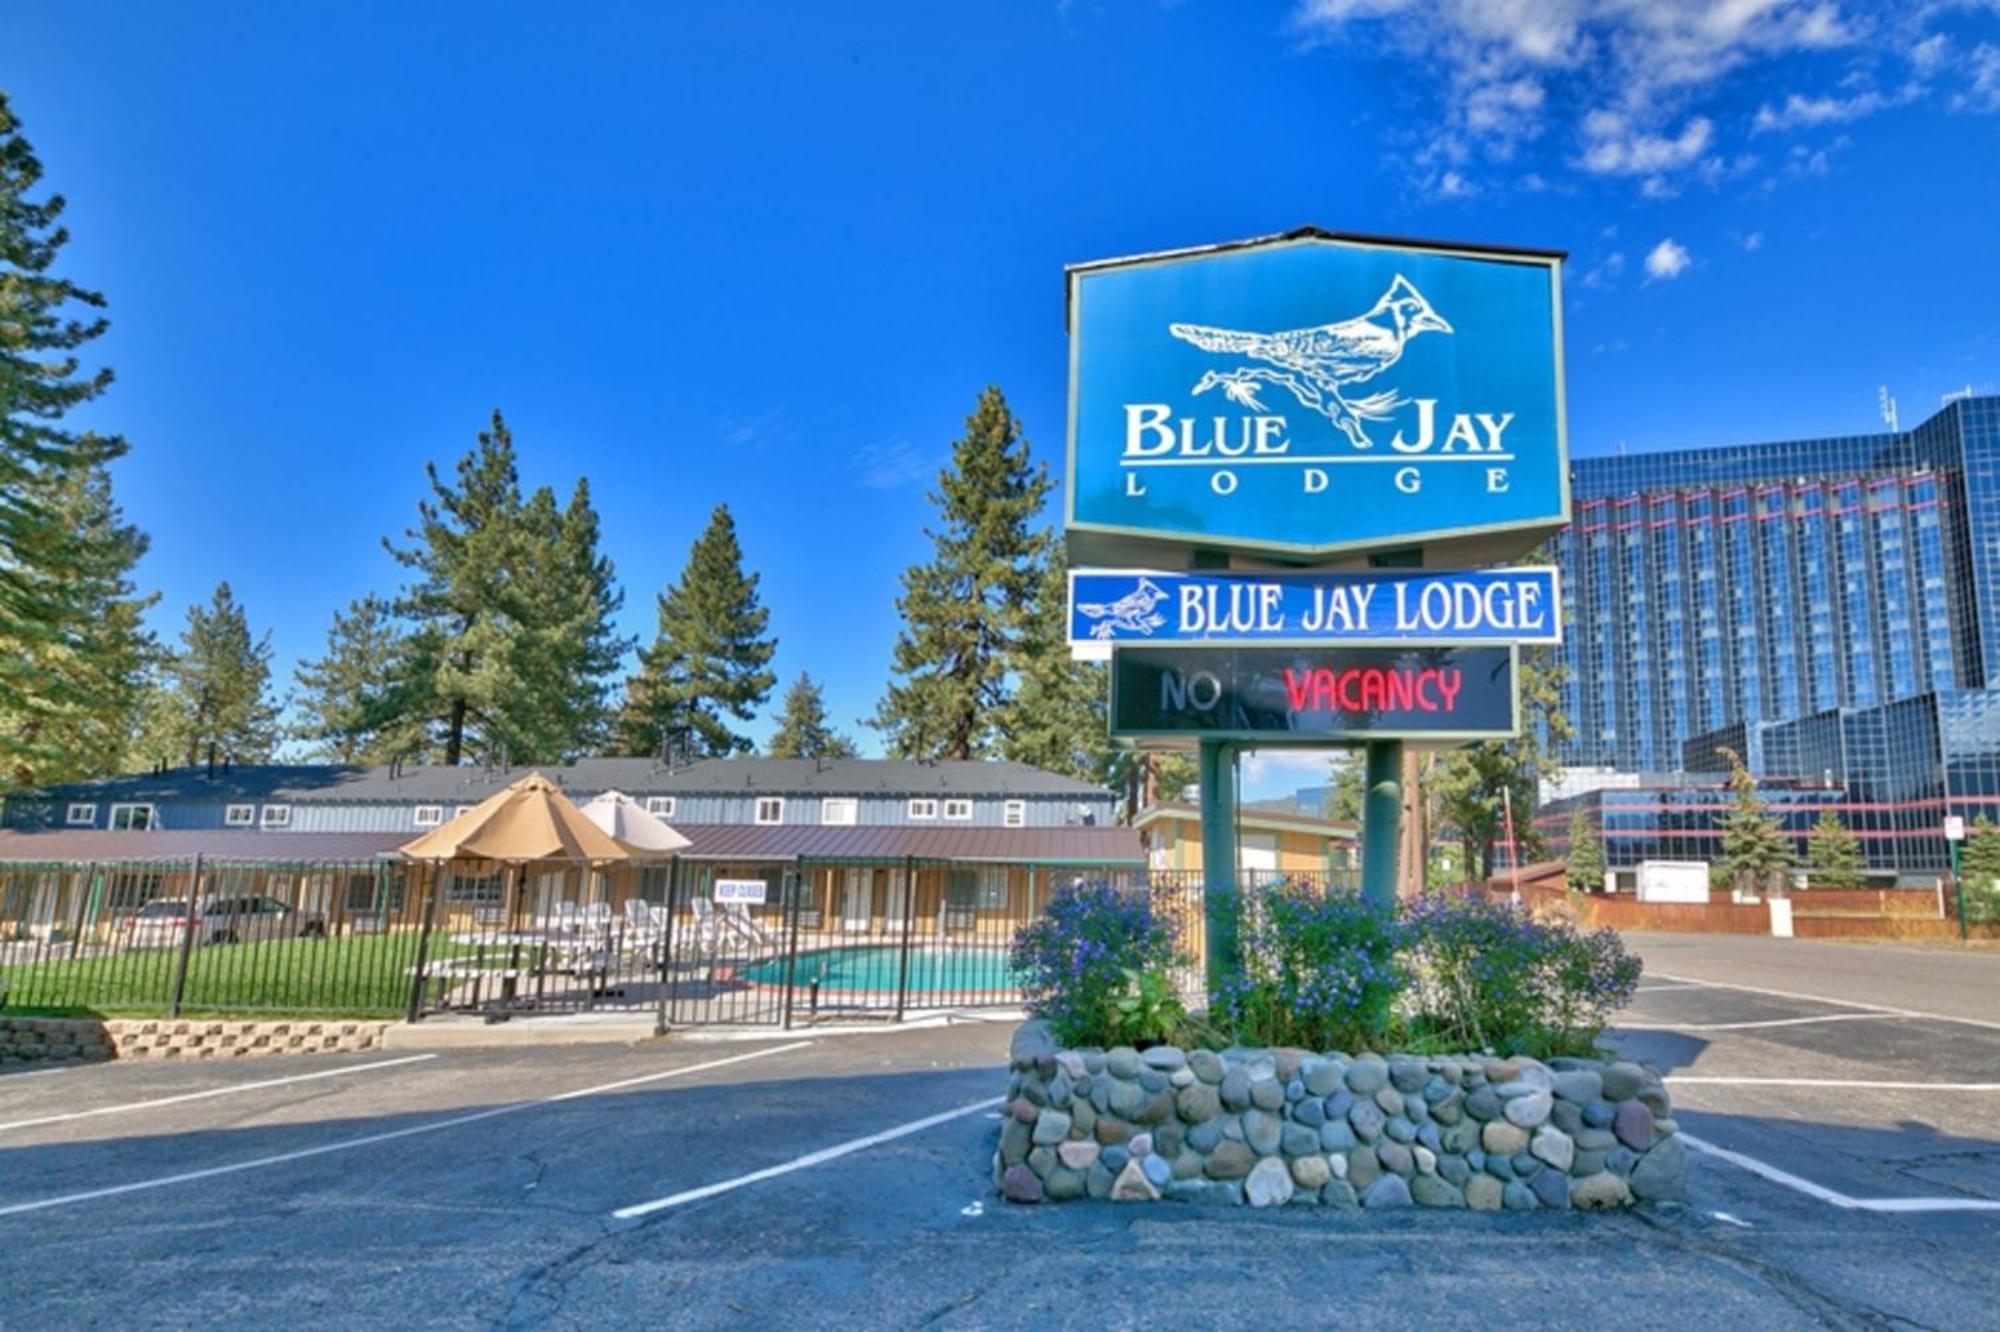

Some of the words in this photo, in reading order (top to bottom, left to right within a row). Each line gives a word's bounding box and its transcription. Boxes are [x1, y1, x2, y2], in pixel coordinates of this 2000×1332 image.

[1123, 404, 1290, 456] BLUE
[1391, 399, 1515, 454] JAY
[1126, 467, 1509, 496] LODGE
[1178, 583, 1284, 632] BLUE
[1301, 582, 1375, 633] JAY
[1398, 580, 1543, 630] LODGE
[1161, 672, 1221, 711] NO
[1282, 668, 1462, 712] VACANCY
